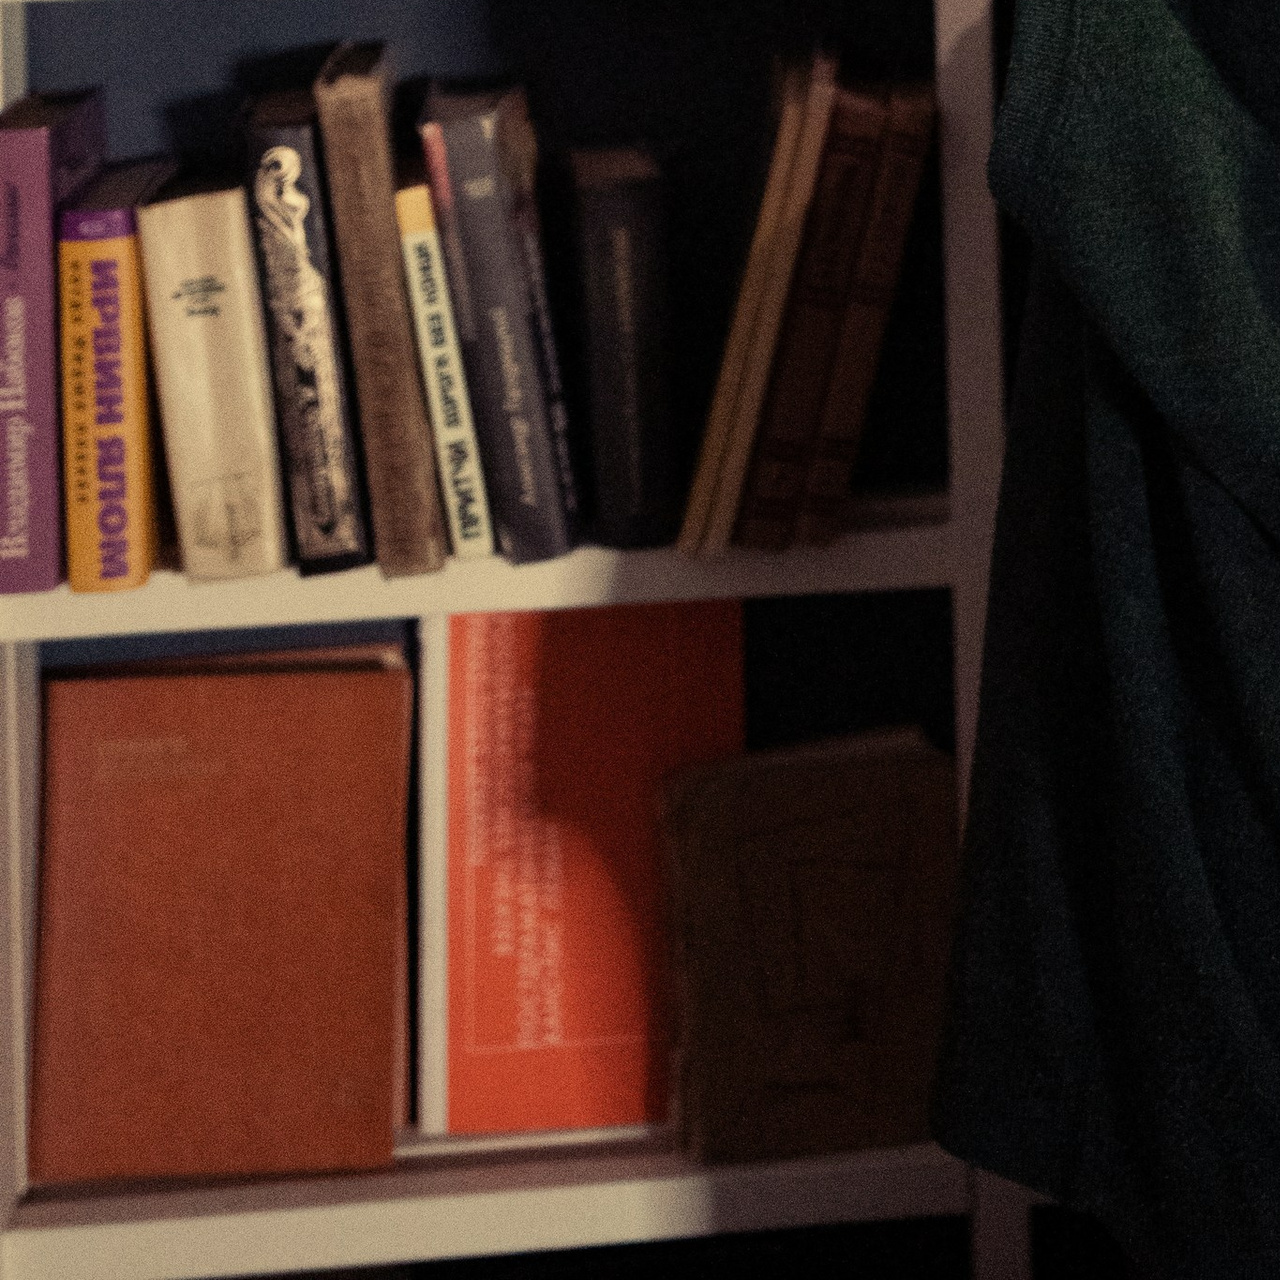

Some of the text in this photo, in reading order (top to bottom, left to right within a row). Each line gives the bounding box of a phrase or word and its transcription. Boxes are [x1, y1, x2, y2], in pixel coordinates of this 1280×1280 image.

[90, 259, 129, 580] ИРВИН ЯЛОМ
[444, 434, 484, 541] ПРИТЧИ
